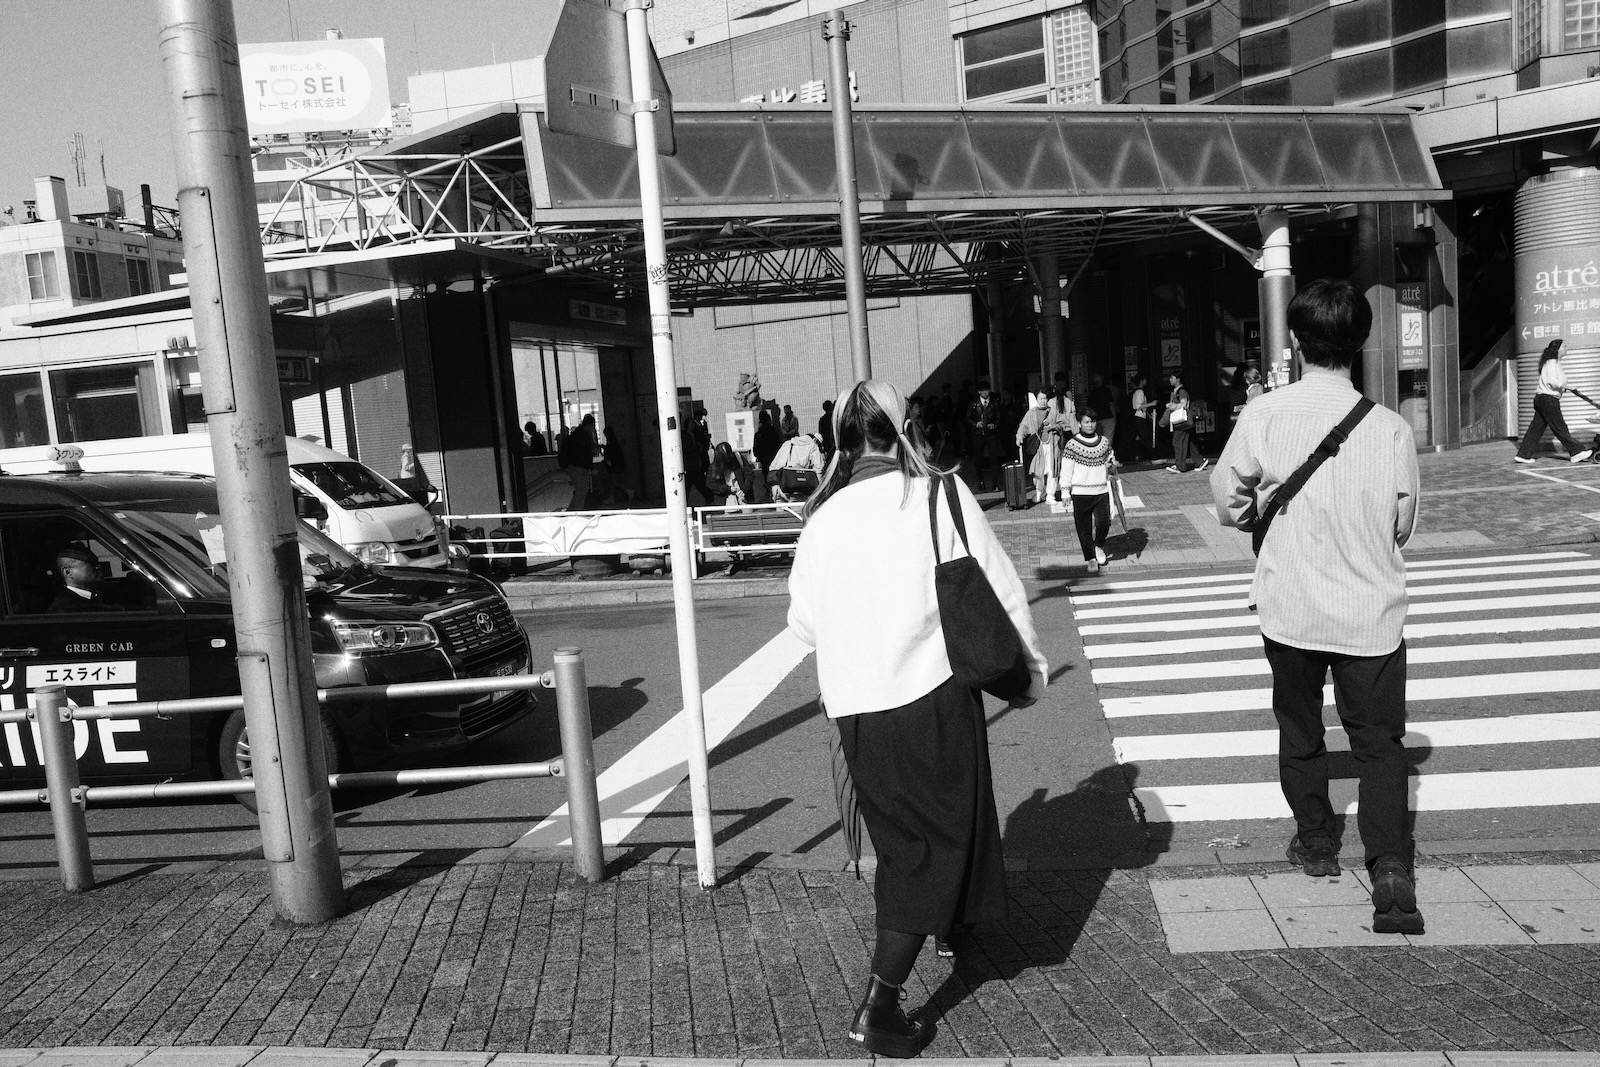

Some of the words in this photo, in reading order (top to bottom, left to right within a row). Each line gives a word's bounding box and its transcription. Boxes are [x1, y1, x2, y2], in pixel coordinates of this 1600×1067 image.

[255, 76, 345, 97] TOSEI
[259, 97, 347, 111] トーセイ株式会社
[1535, 261, 1599, 291] atré
[1401, 286, 1421, 300] atré
[1533, 298, 1600, 314] アトレ恵比寿
[65, 643, 104, 653] GREEN
[110, 642, 133, 651] CAB
[45, 666, 116, 682] エスライド
